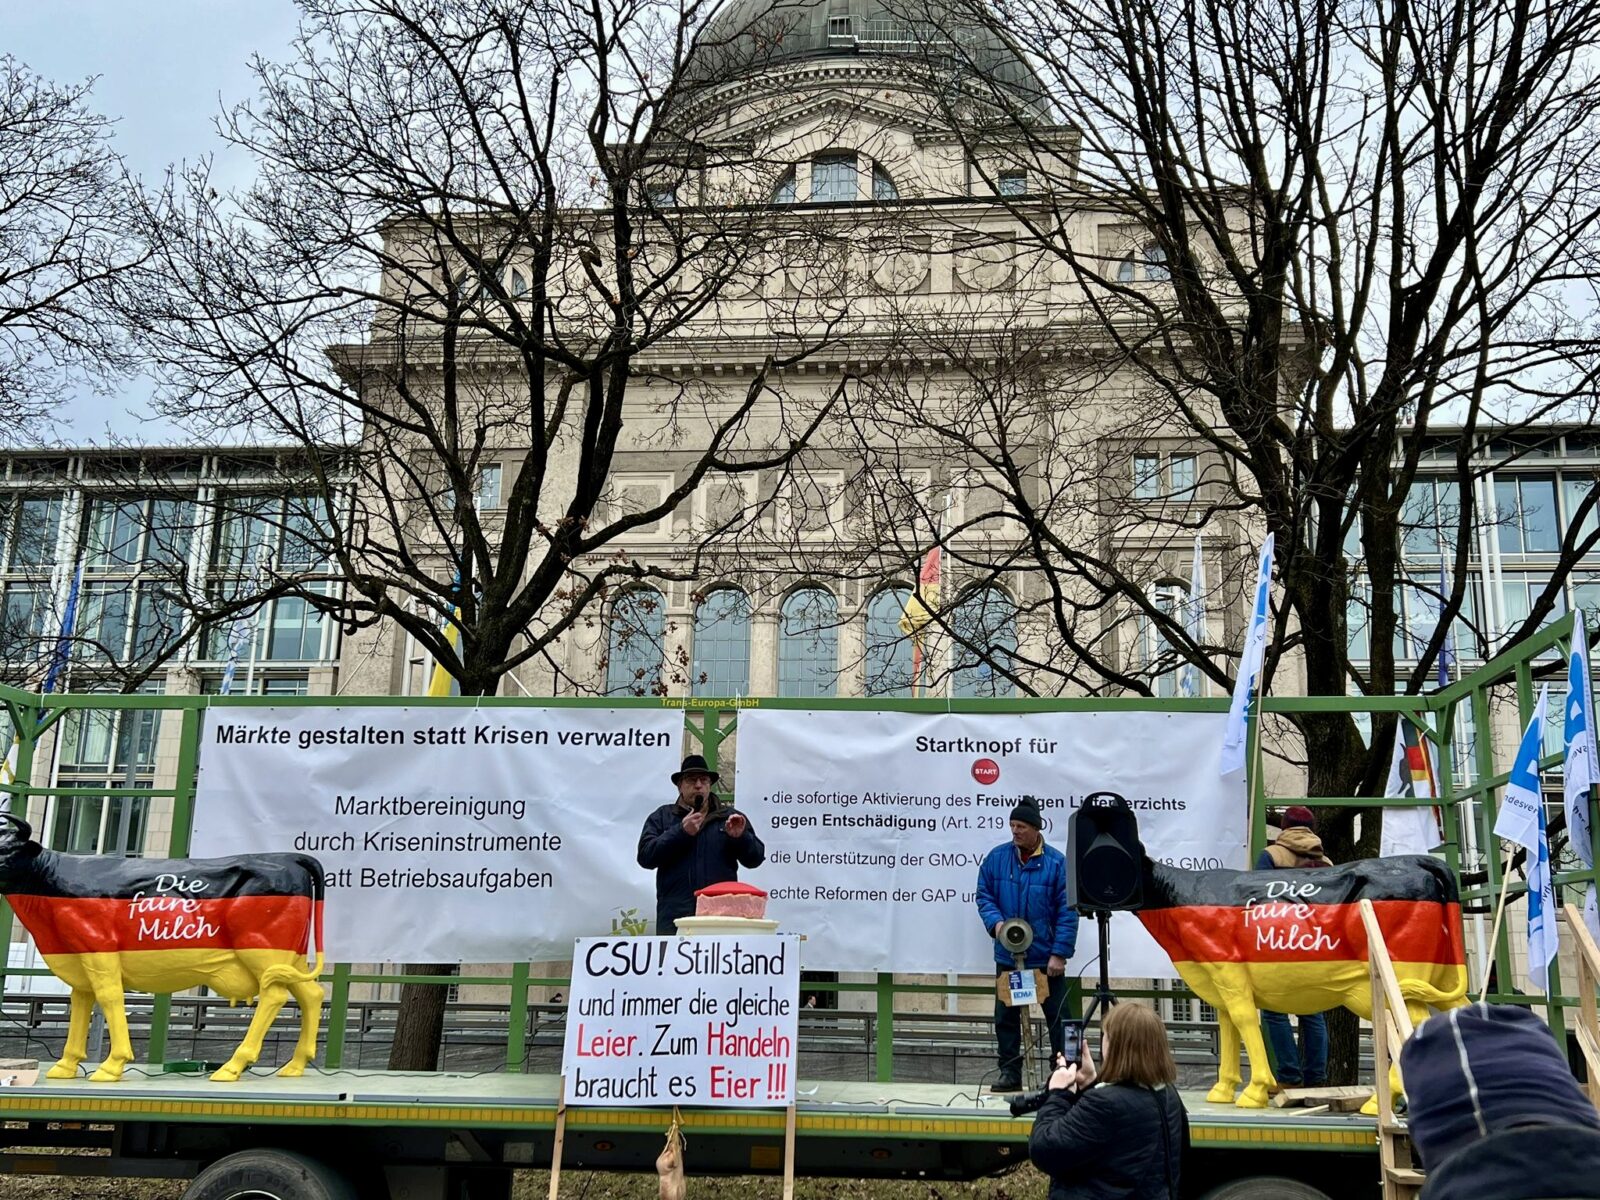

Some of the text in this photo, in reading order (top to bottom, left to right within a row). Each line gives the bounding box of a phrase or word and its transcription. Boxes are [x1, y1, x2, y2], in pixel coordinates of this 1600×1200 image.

[661, 698, 760, 709] Trans-Europa-GmbH
[216, 724, 671, 747] Märkte gestalten statt Krisen verwalten
[916, 736, 1058, 757] Startknopf für
[335, 795, 526, 820] Marktbereinigung
[771, 791, 793, 804] die
[797, 791, 858, 808] sofortige
[862, 792, 941, 809] Aktivierung
[946, 794, 971, 806] des
[771, 815, 817, 829] gegen
[823, 814, 936, 831] Entschädigung
[942, 815, 972, 832] (Art.
[977, 816, 1004, 829] 219
[294, 831, 562, 853] durch Kriseninstrumente
[770, 850, 791, 864] die
[796, 851, 896, 869] Unterstützung
[900, 854, 924, 867] der
[928, 853, 984, 867] GMO-V
[155, 873, 210, 894] Die
[360, 868, 554, 893] Betriebsaufgaben
[1265, 880, 1322, 898] Die
[127, 891, 203, 919] faire
[770, 886, 810, 900] echte
[815, 886, 888, 902] Reformen
[892, 888, 917, 902] der
[921, 888, 957, 903] GAP
[1241, 897, 1316, 928] faire
[138, 916, 221, 942] Milch
[1255, 925, 1341, 952] Milch
[586, 941, 785, 977] CSU! Stillstand
[578, 986, 790, 1028] und immer die gleiche
[575, 1021, 790, 1058] Leier. Zum Handeln
[574, 1066, 658, 1098] braucht
[668, 1075, 697, 1098] es
